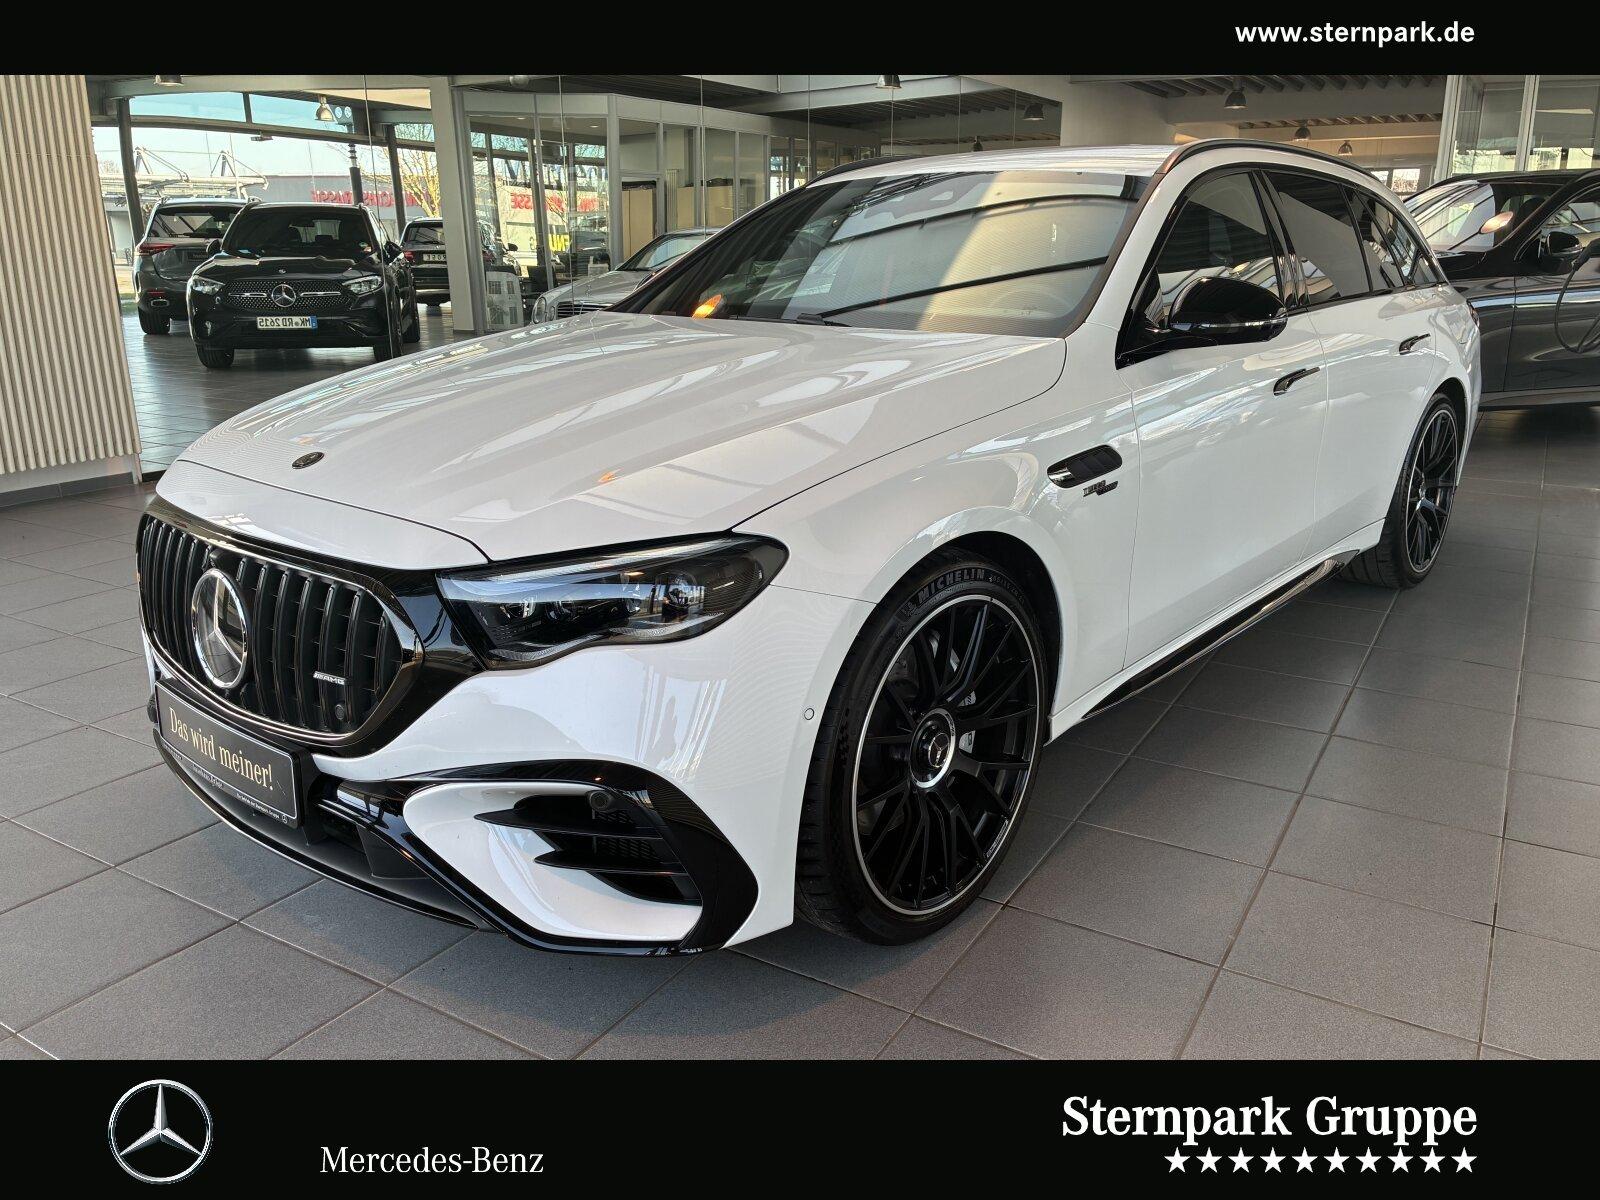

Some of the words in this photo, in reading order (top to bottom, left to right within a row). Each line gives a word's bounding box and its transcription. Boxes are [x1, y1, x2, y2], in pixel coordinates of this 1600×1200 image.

[918, 568, 985, 603] MICHELIN
[169, 707, 189, 742] Das
[191, 728, 216, 760] wird
[219, 746, 274, 791] meiner!
